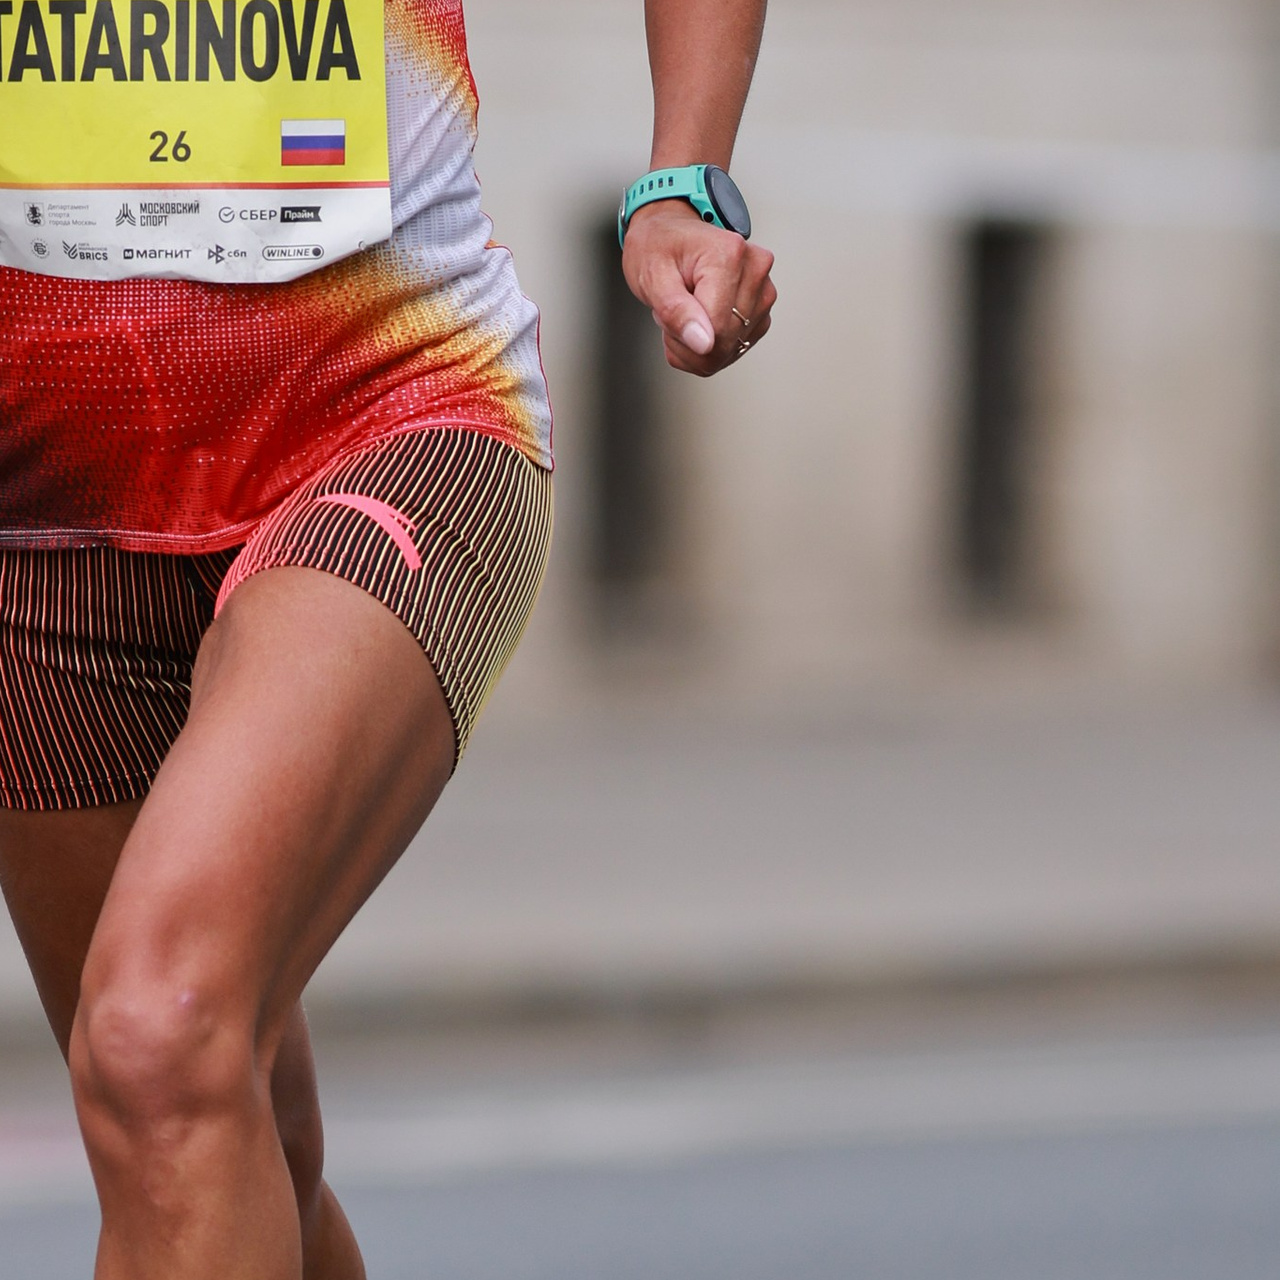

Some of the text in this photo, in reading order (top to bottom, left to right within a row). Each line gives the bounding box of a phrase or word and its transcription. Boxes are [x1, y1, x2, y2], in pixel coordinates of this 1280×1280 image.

[149, 130, 191, 162] 26
[140, 200, 200, 214] МОСКОВСКИЙ
[140, 215, 168, 226] СПОРТ
[239, 209, 314, 221] СБЕР Прайм
[79, 251, 108, 260] BRICS
[267, 248, 310, 258] WINLINE
